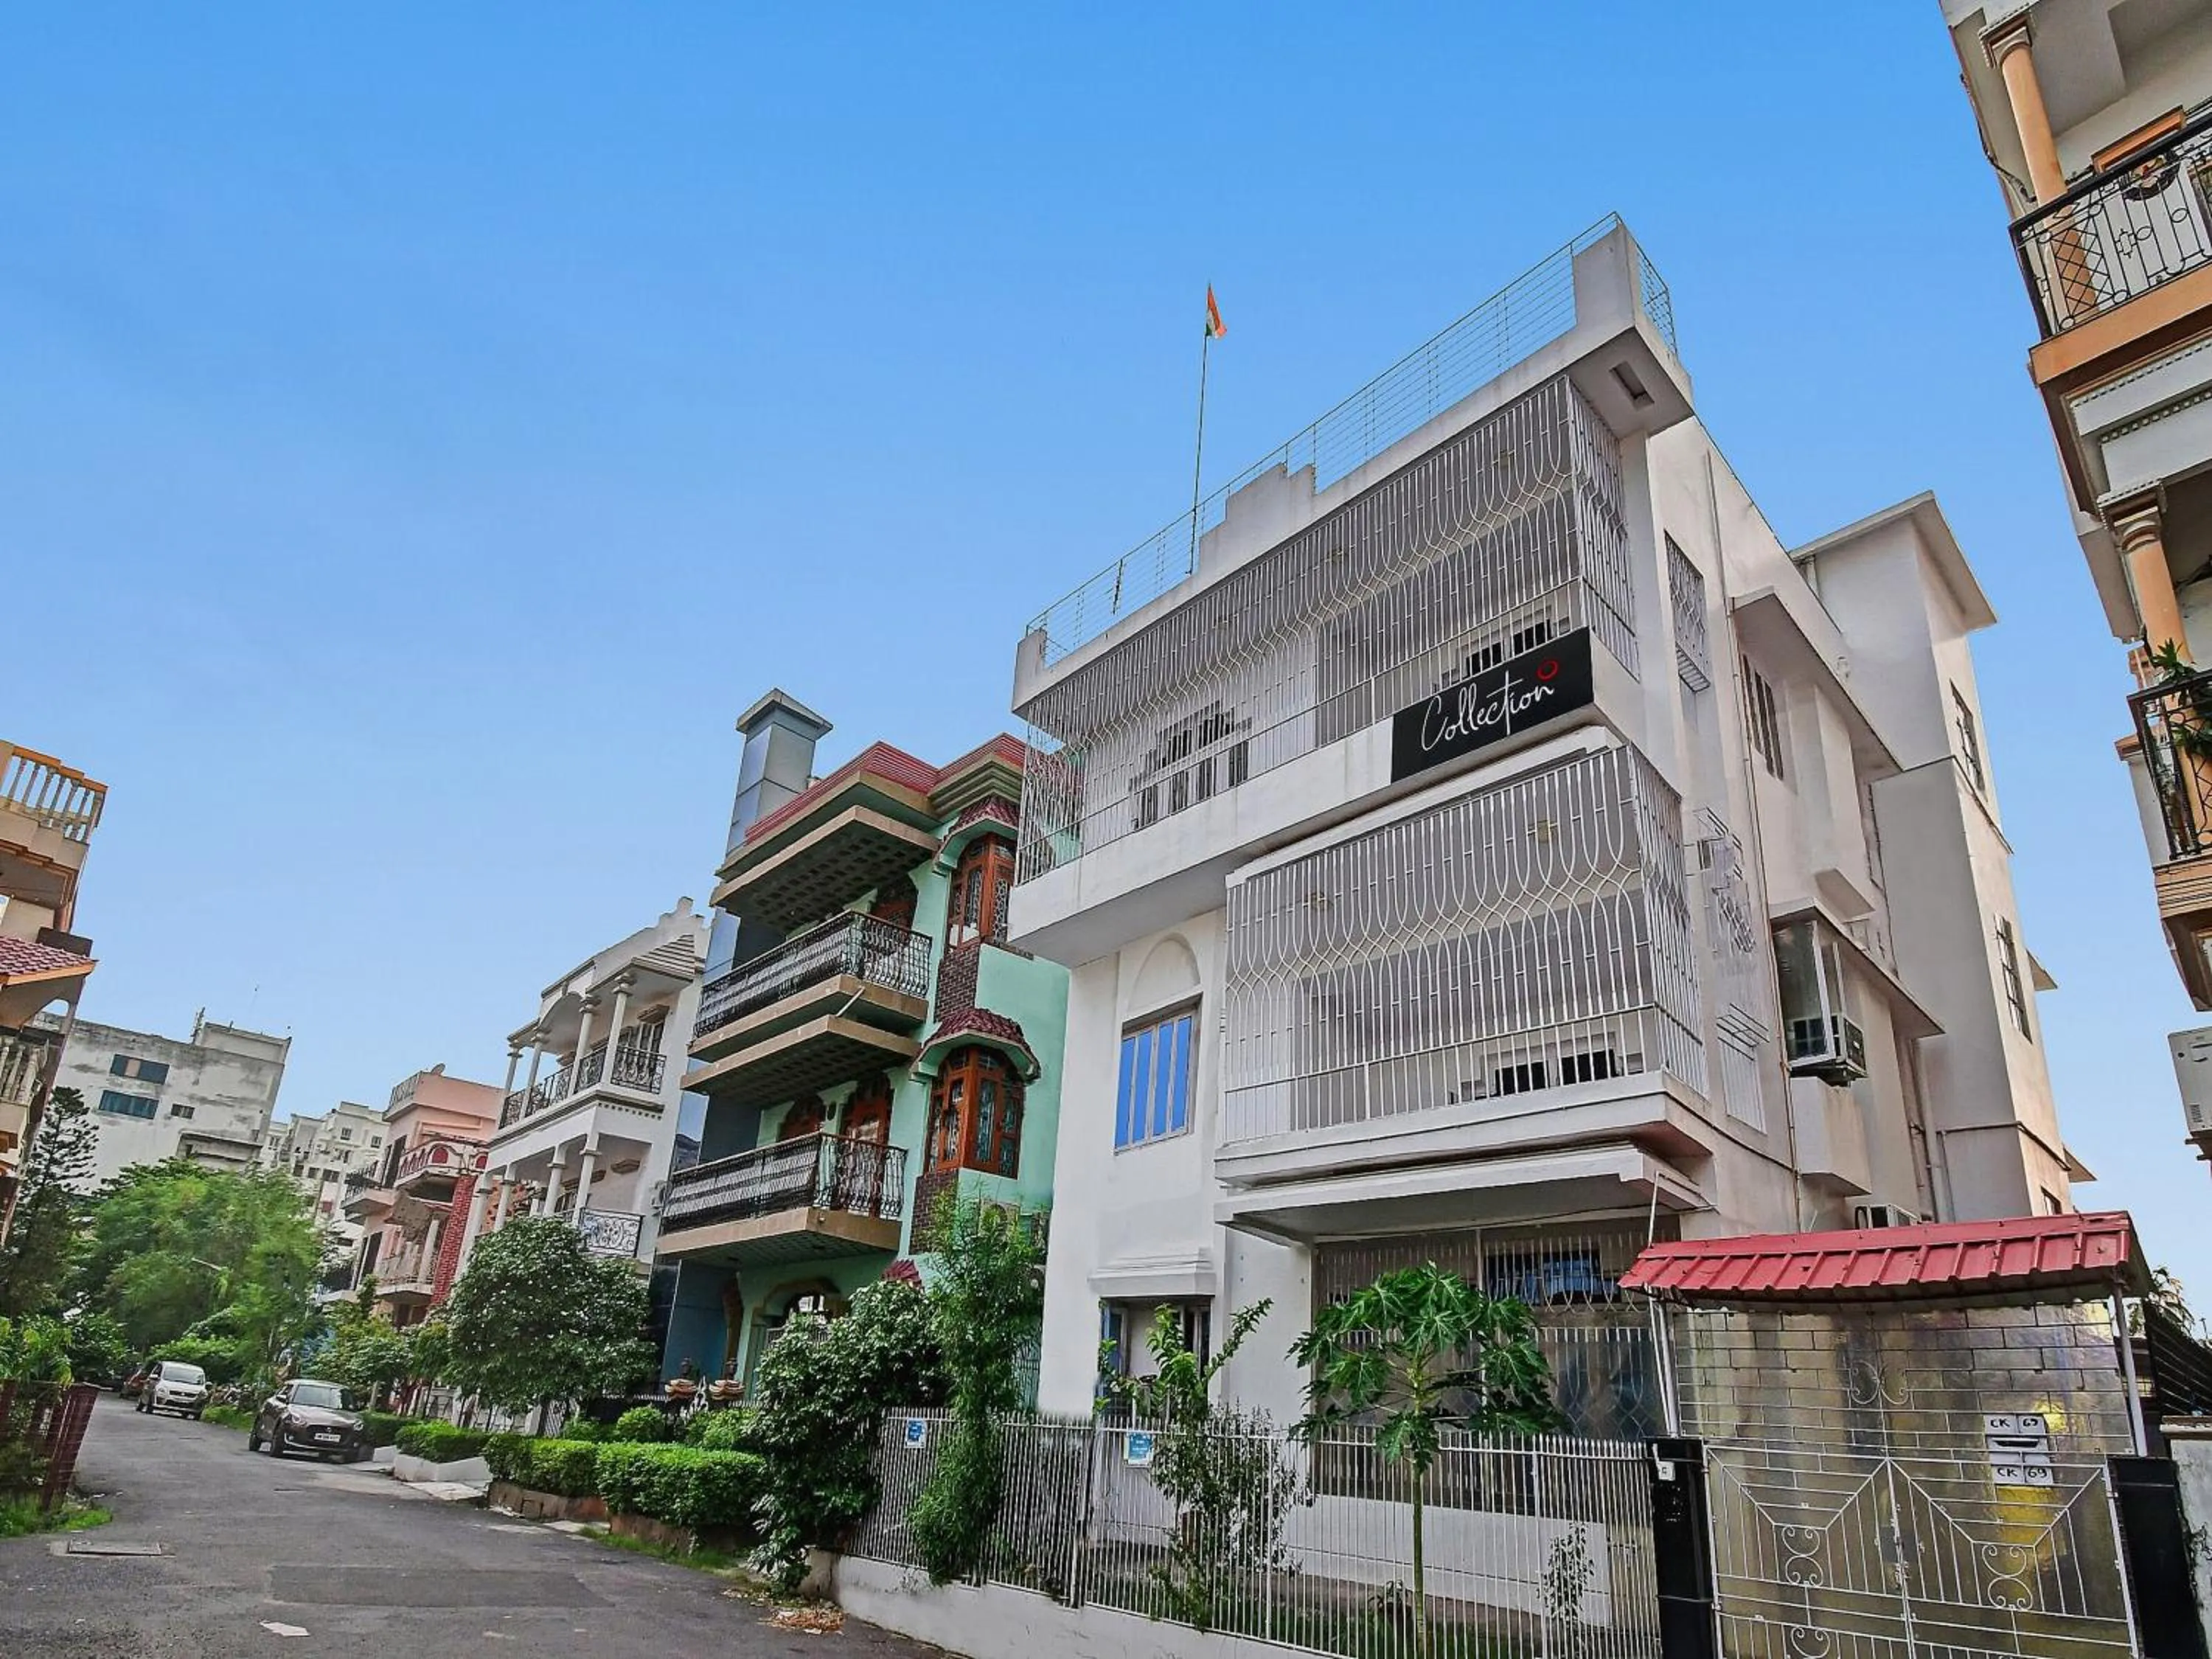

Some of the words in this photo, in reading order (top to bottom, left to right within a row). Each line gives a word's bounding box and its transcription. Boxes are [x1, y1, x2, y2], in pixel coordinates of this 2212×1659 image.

[1421, 670, 1554, 751] Collection
[1990, 1418, 2010, 1428] CK
[1997, 1467, 2018, 1477] CK
[2028, 1467, 2048, 1478] 69
